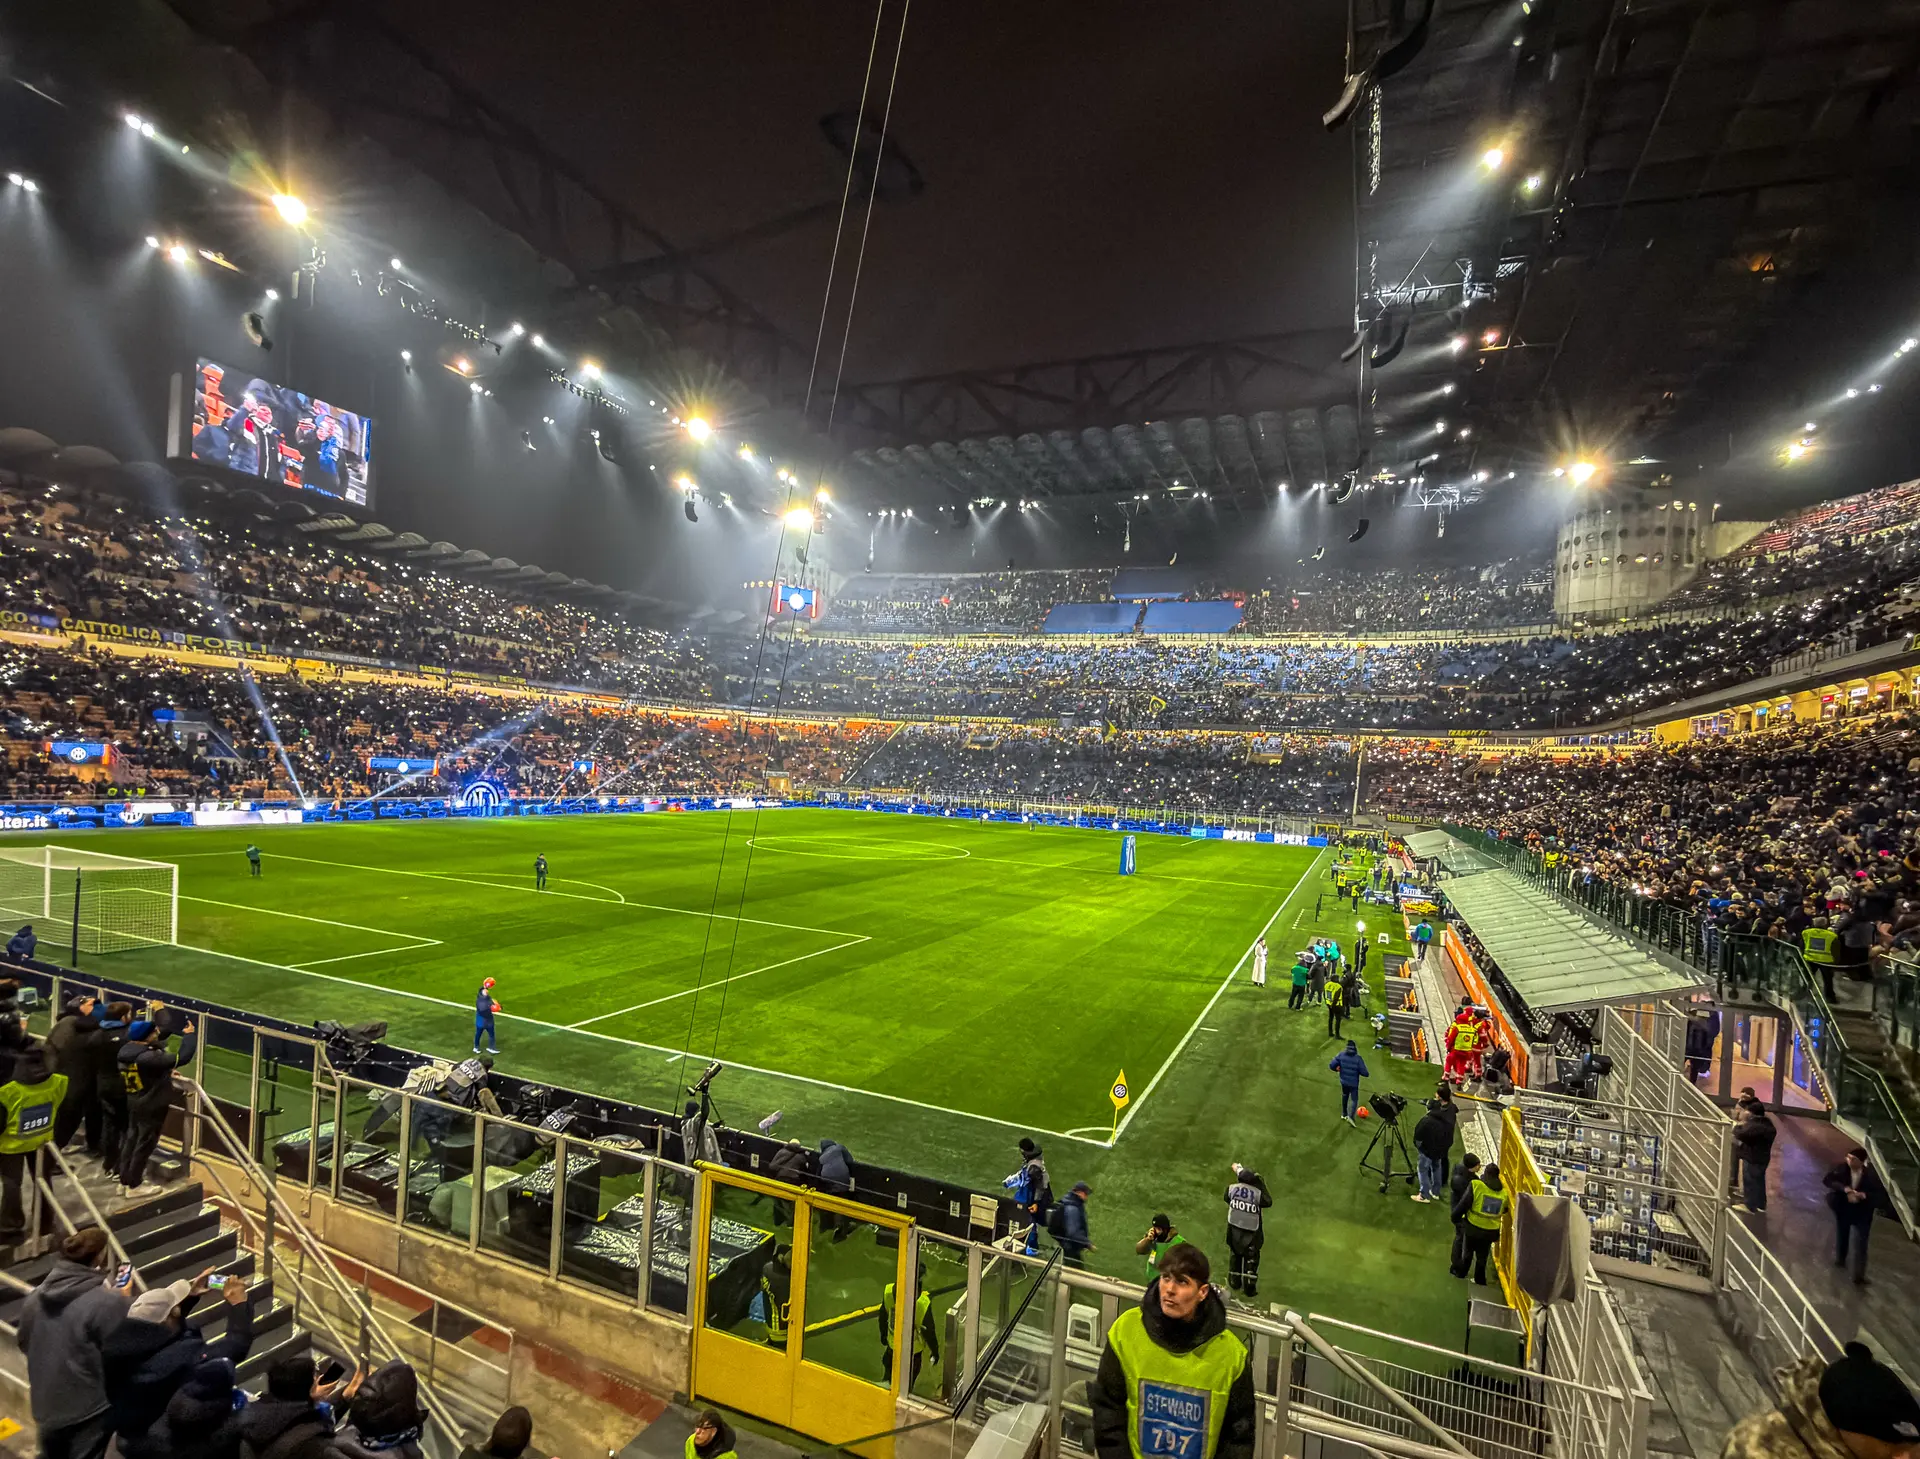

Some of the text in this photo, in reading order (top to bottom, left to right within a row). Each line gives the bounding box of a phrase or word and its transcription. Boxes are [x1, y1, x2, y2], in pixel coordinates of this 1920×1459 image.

[61, 617, 162, 641] CATTOLICA
[1387, 813, 1422, 823] BERNALDA
[1147, 1392, 1202, 1422] STEWARD
[1151, 1427, 1195, 1455] 797
